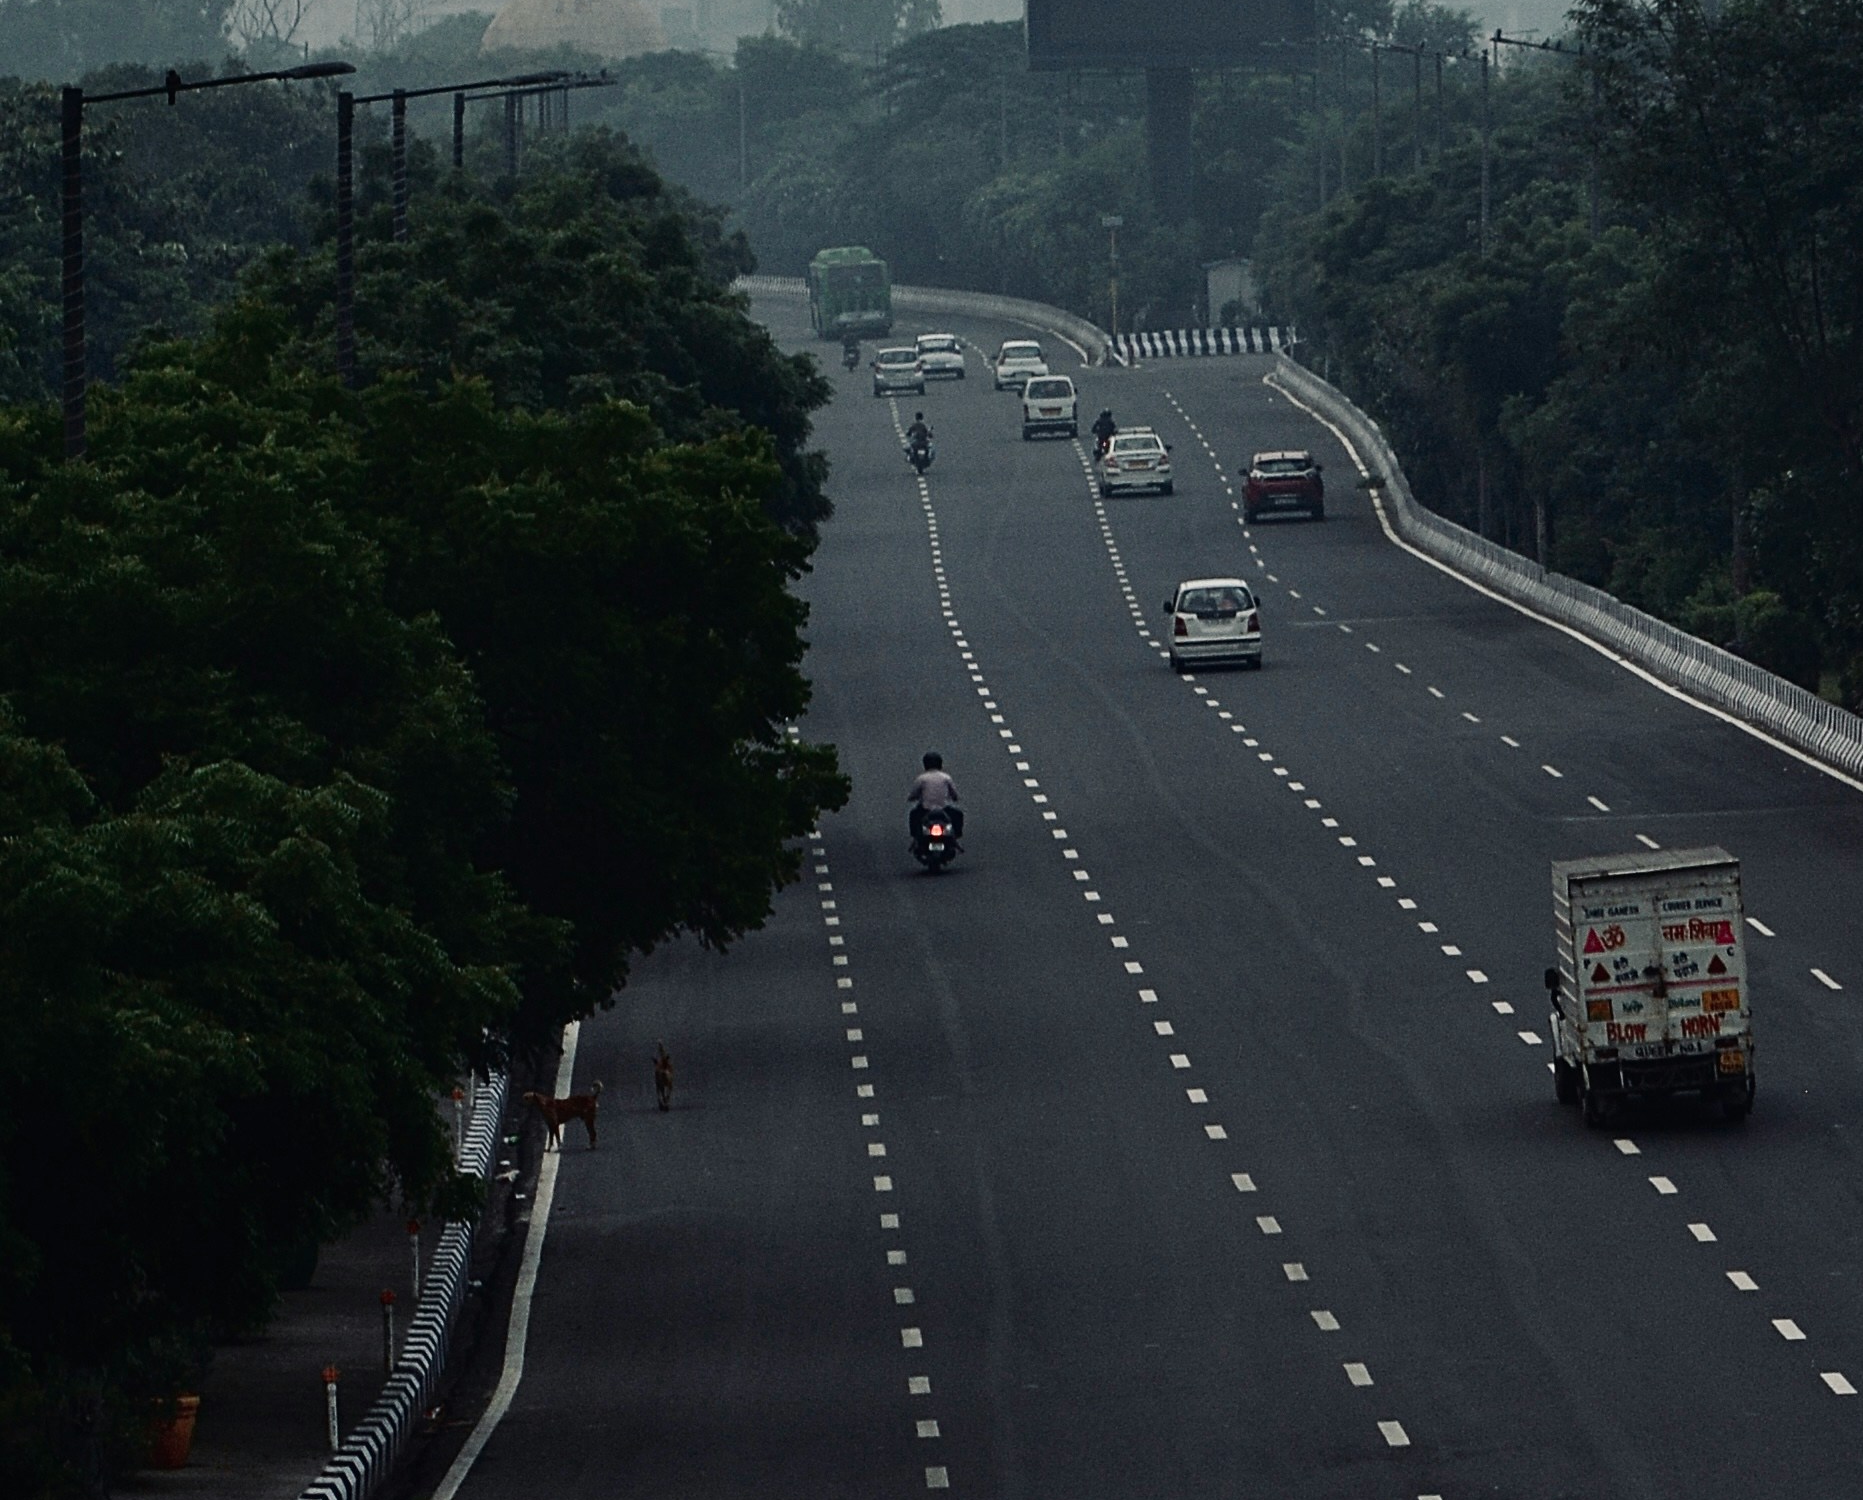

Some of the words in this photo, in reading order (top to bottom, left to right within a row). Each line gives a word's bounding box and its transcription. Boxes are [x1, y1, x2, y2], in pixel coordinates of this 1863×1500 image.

[1606, 1022, 1647, 1043] BLOW
[1681, 1015, 1721, 1038] HORN
[1635, 1043, 1673, 1057] QUEEN
